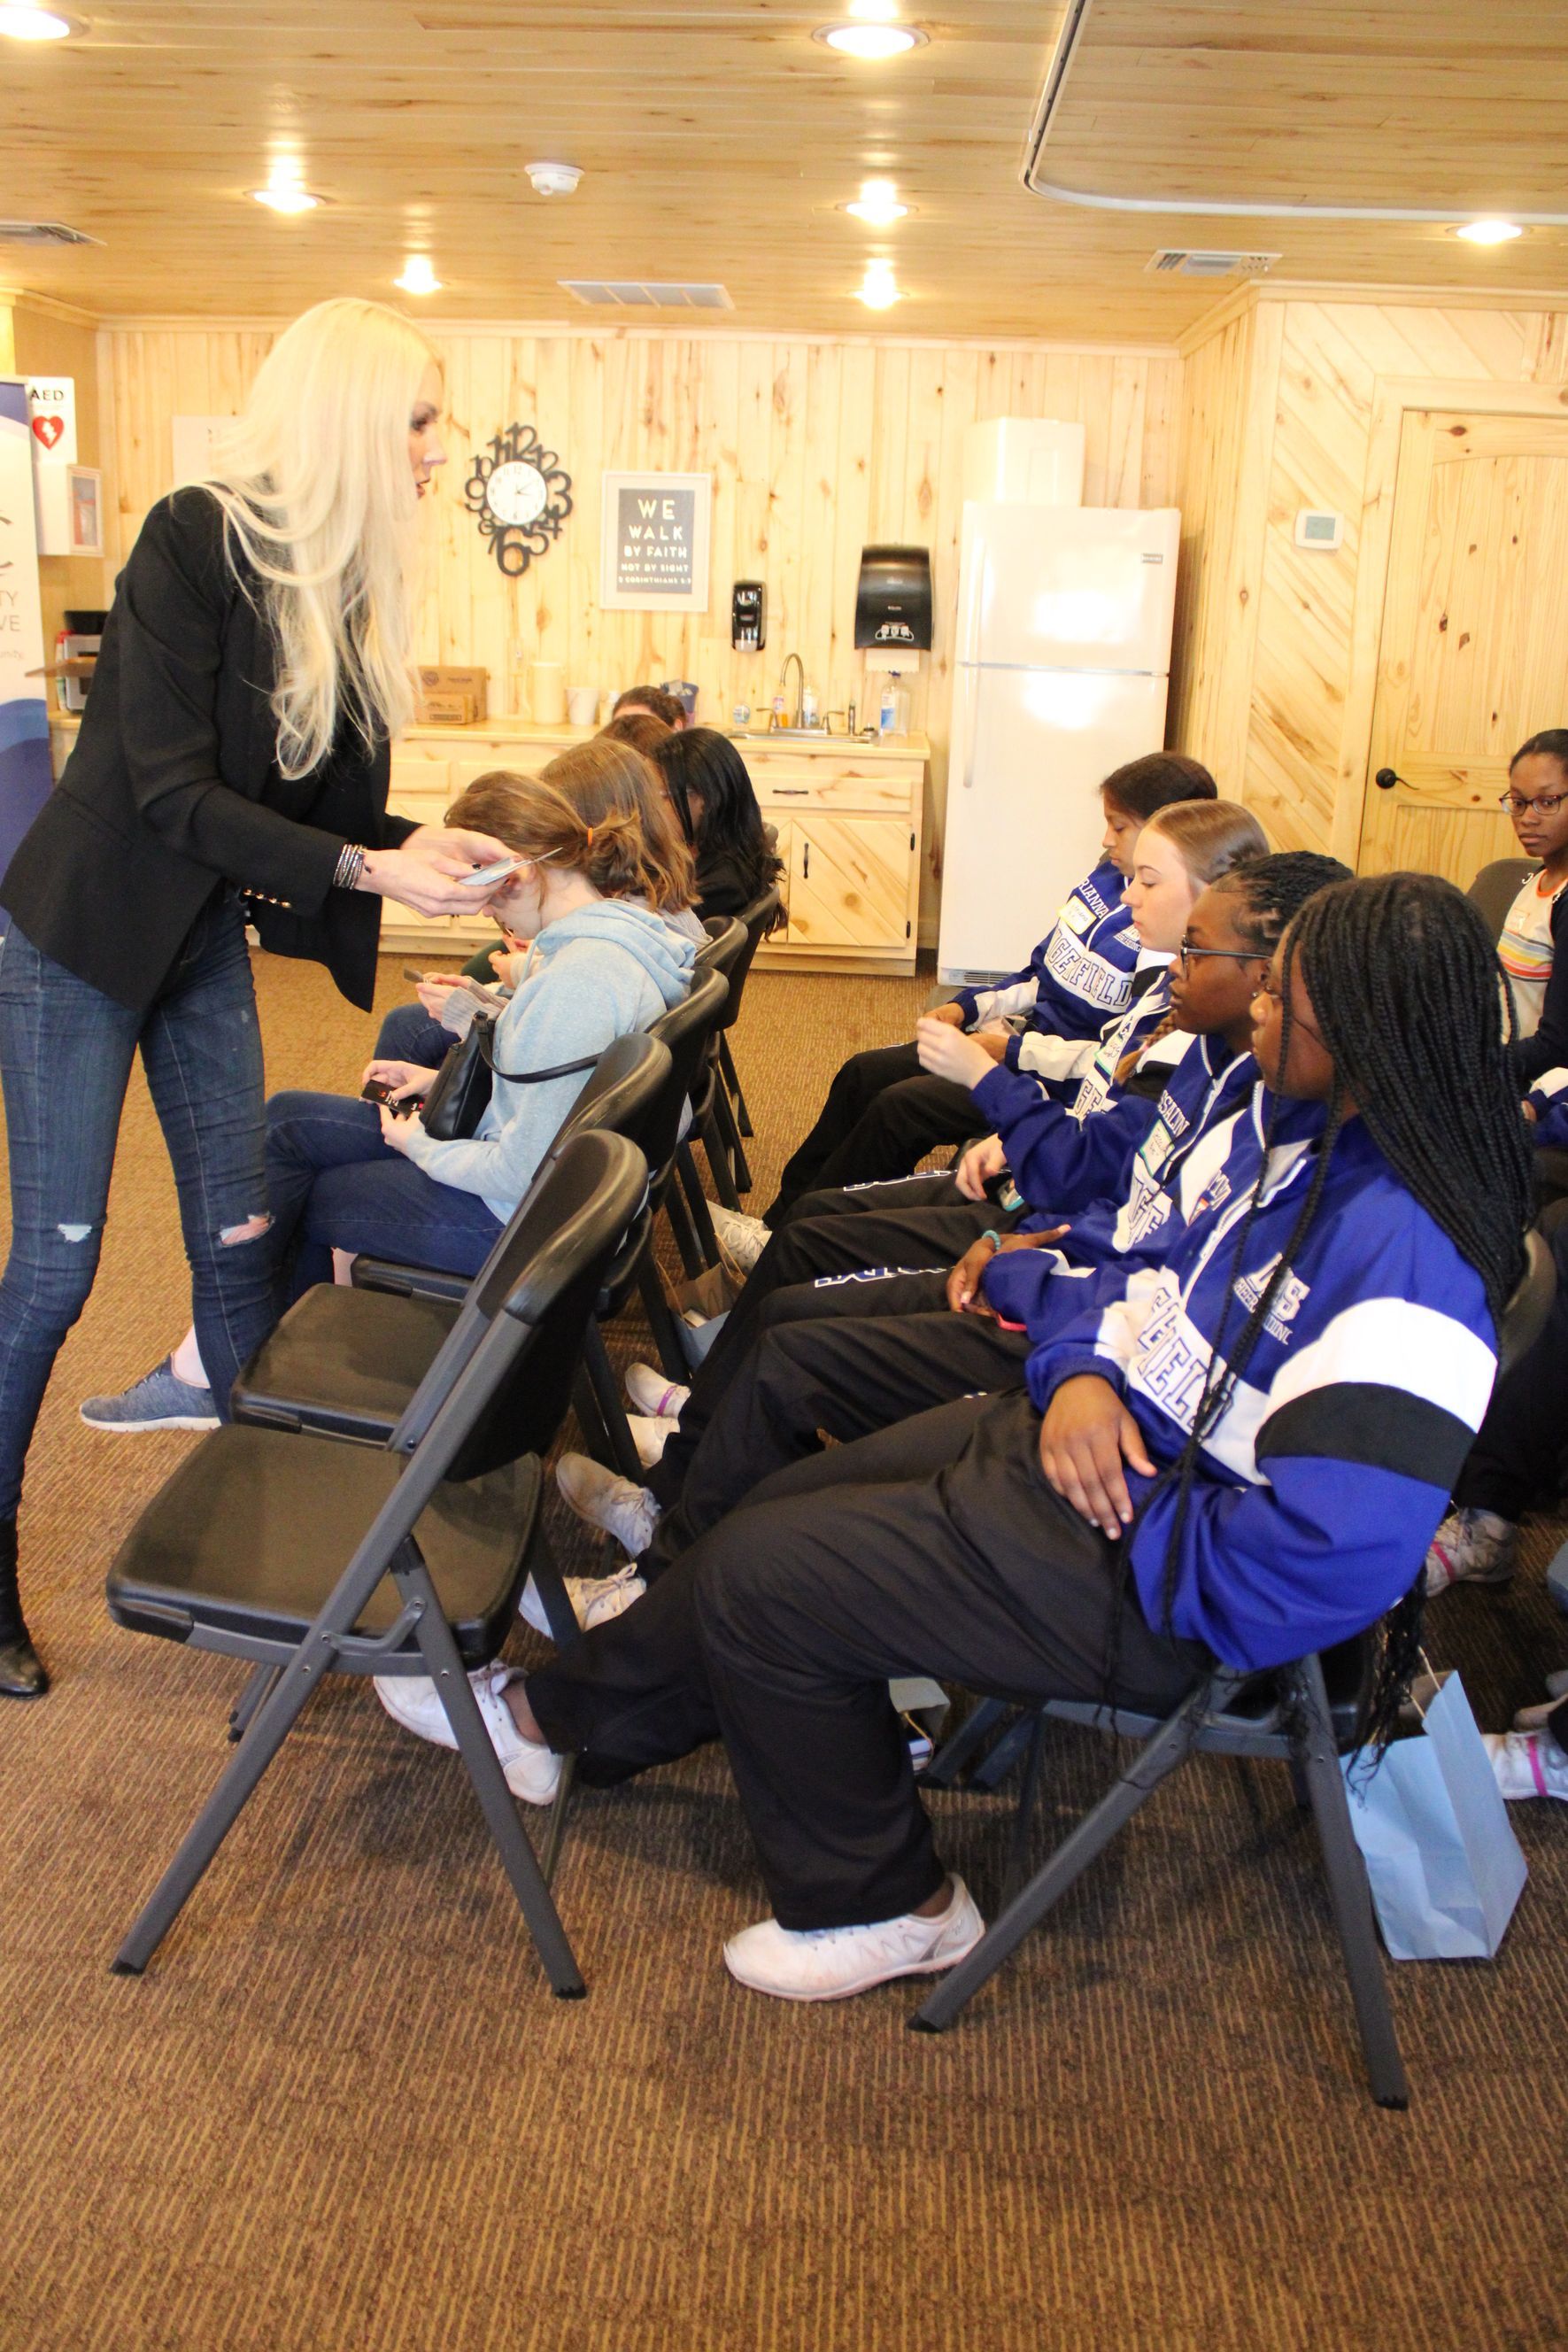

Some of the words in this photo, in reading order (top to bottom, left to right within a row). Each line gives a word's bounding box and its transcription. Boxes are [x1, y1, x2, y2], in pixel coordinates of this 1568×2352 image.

[29, 388, 65, 401] AED
[545, 470, 574, 520] 3
[637, 499, 676, 520] WE
[629, 524, 683, 540] WALK
[623, 545, 641, 557] BY
[646, 545, 687, 559] FAITH
[621, 563, 640, 572] NOT
[644, 563, 657, 572] BY
[660, 564, 689, 573] SIGHT
[625, 576, 678, 584] CORINTHIANS
[1047, 929, 1133, 1007] GEFIELD
